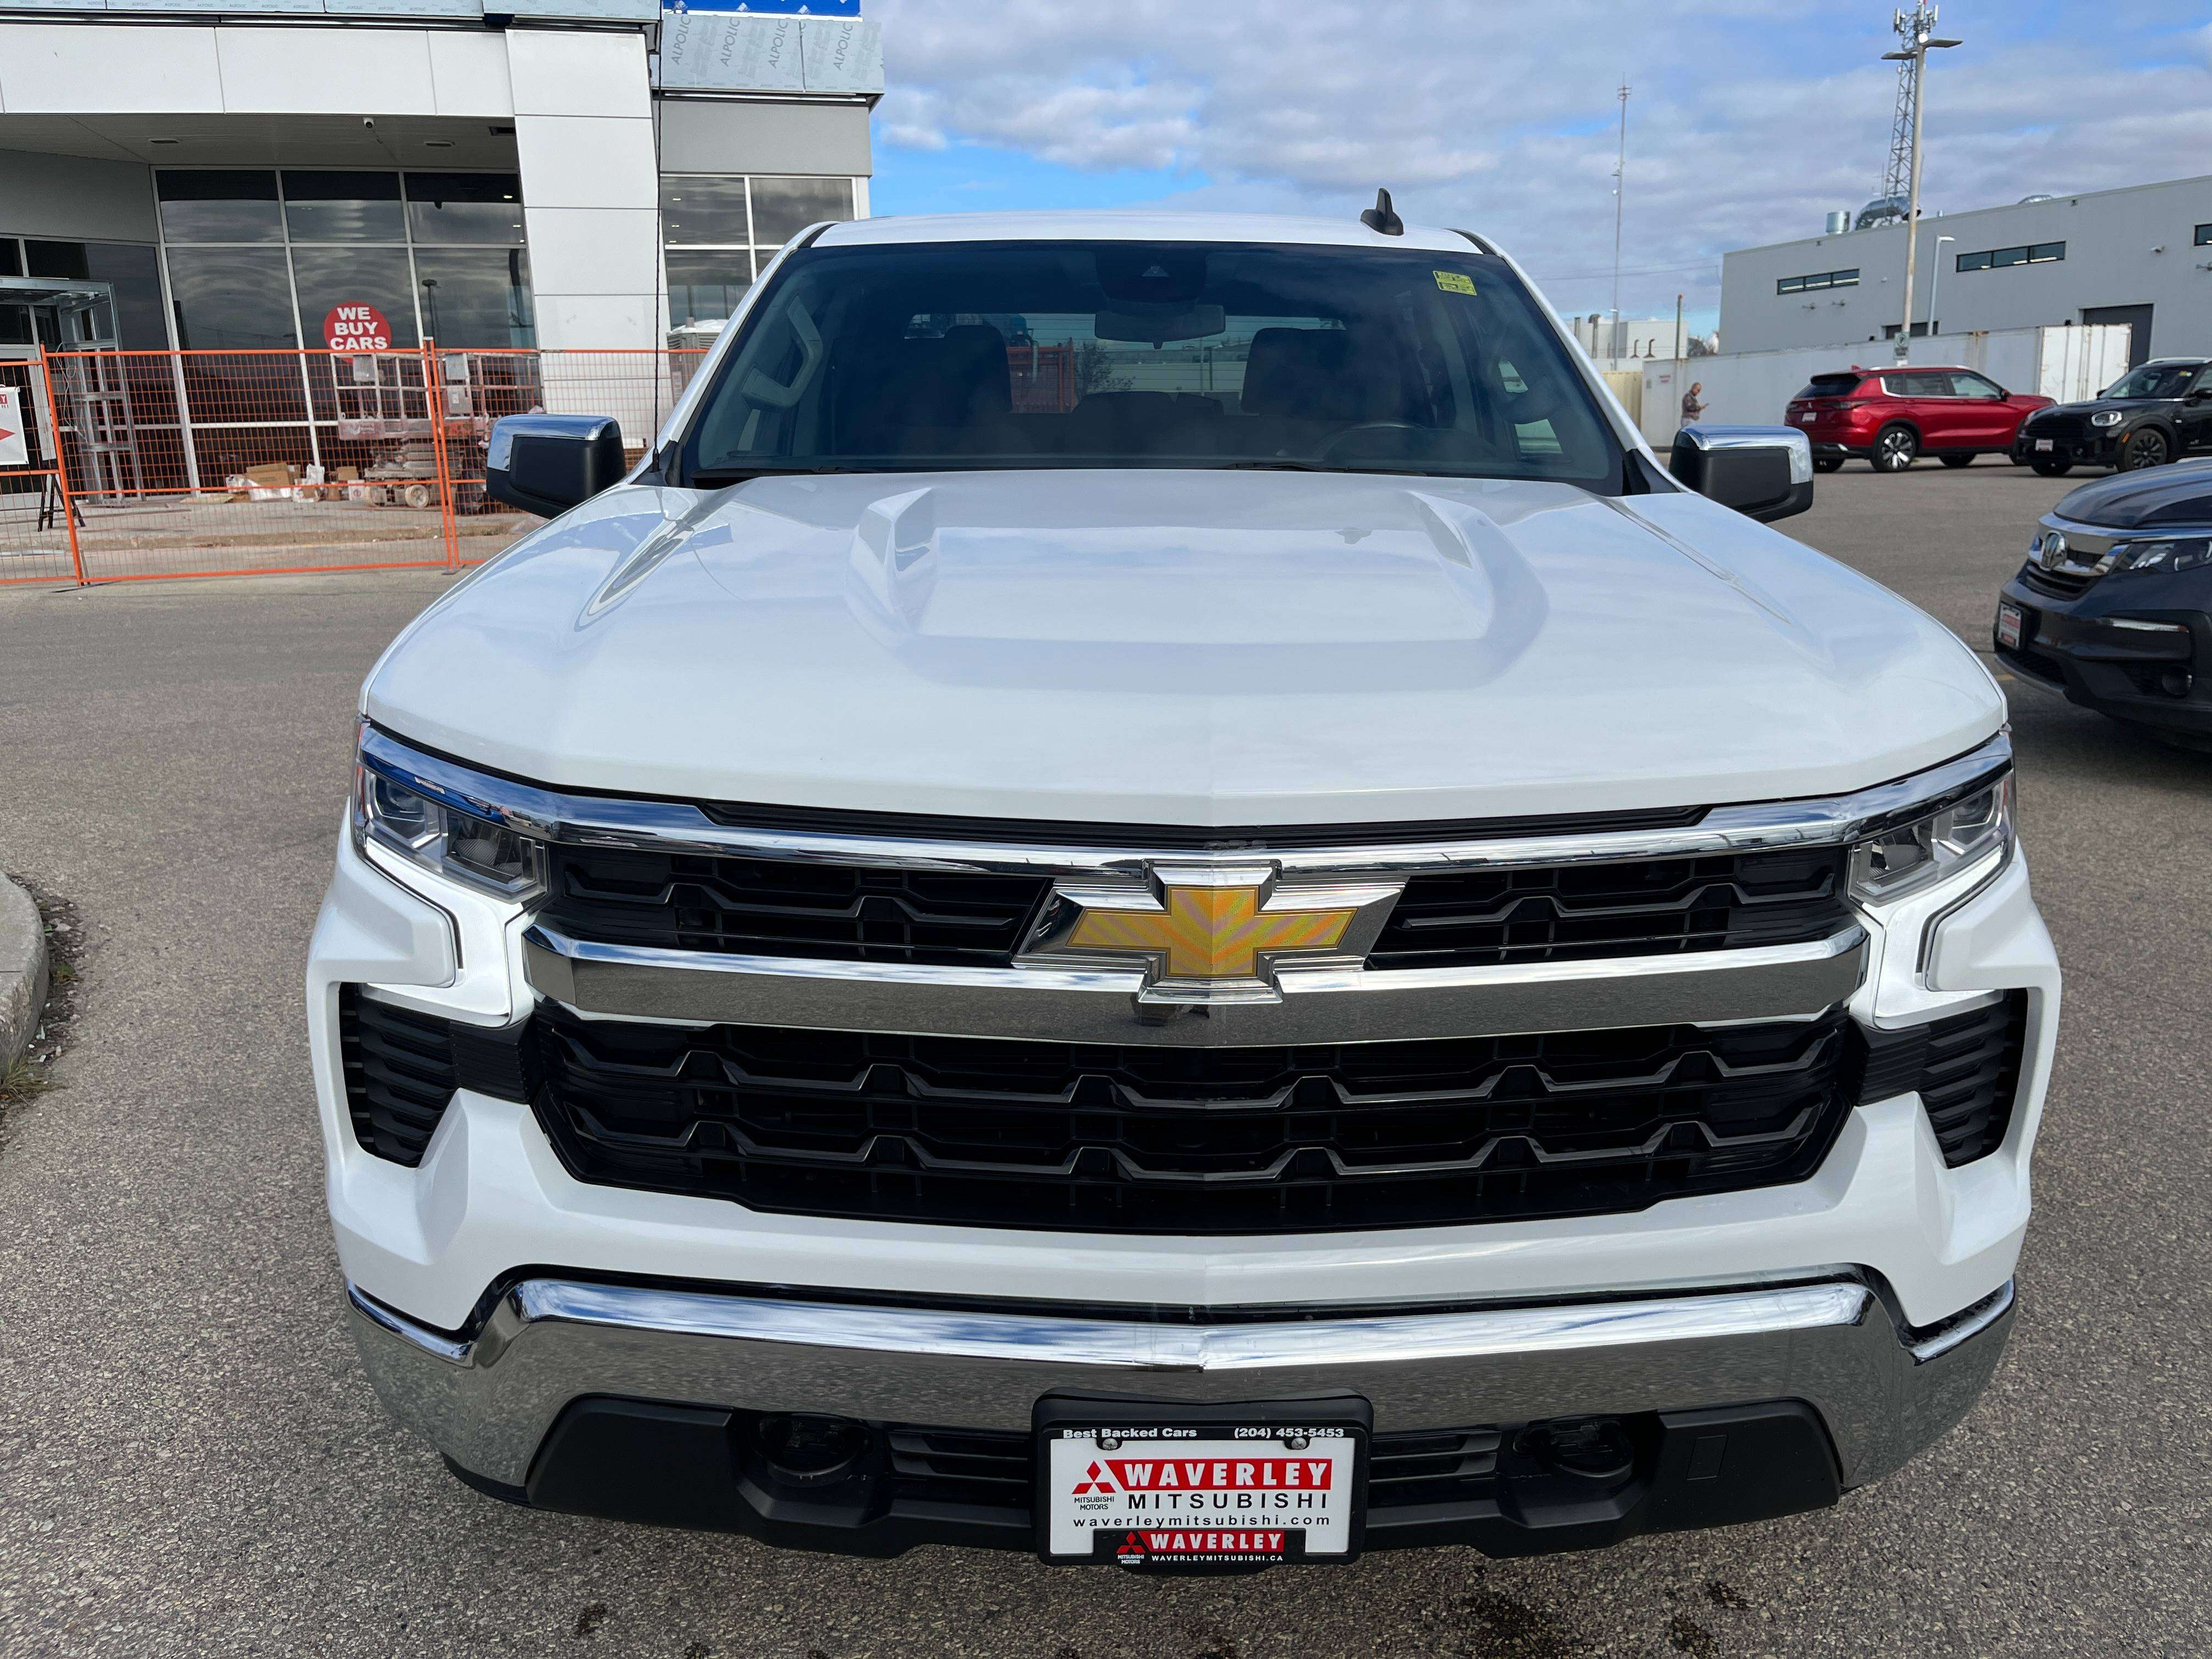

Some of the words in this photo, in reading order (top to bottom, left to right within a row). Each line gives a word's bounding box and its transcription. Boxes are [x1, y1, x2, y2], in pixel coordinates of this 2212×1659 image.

[671, 15, 691, 65] ALPOLIC
[720, 18, 740, 67] ALPOLIC
[769, 19, 788, 68] ALPOLIC
[833, 22, 853, 70] ALPOLIC
[337, 307, 371, 320] WE
[334, 321, 377, 335] BUY
[330, 336, 387, 350] CARS
[1063, 1429, 1097, 1438] Best
[1102, 1428, 1158, 1437] Backed
[1162, 1428, 1197, 1437] Cars
[1234, 1427, 1271, 1438] (204)
[1276, 1428, 1344, 1437] 453-5453
[1124, 1463, 1327, 1486] WAVERLEY
[1128, 1493, 1326, 1509] MITSUBISHI
[1073, 1515, 1329, 1528] waverleymitsubishi.com
[1150, 1533, 1281, 1549] WAVERLEY
